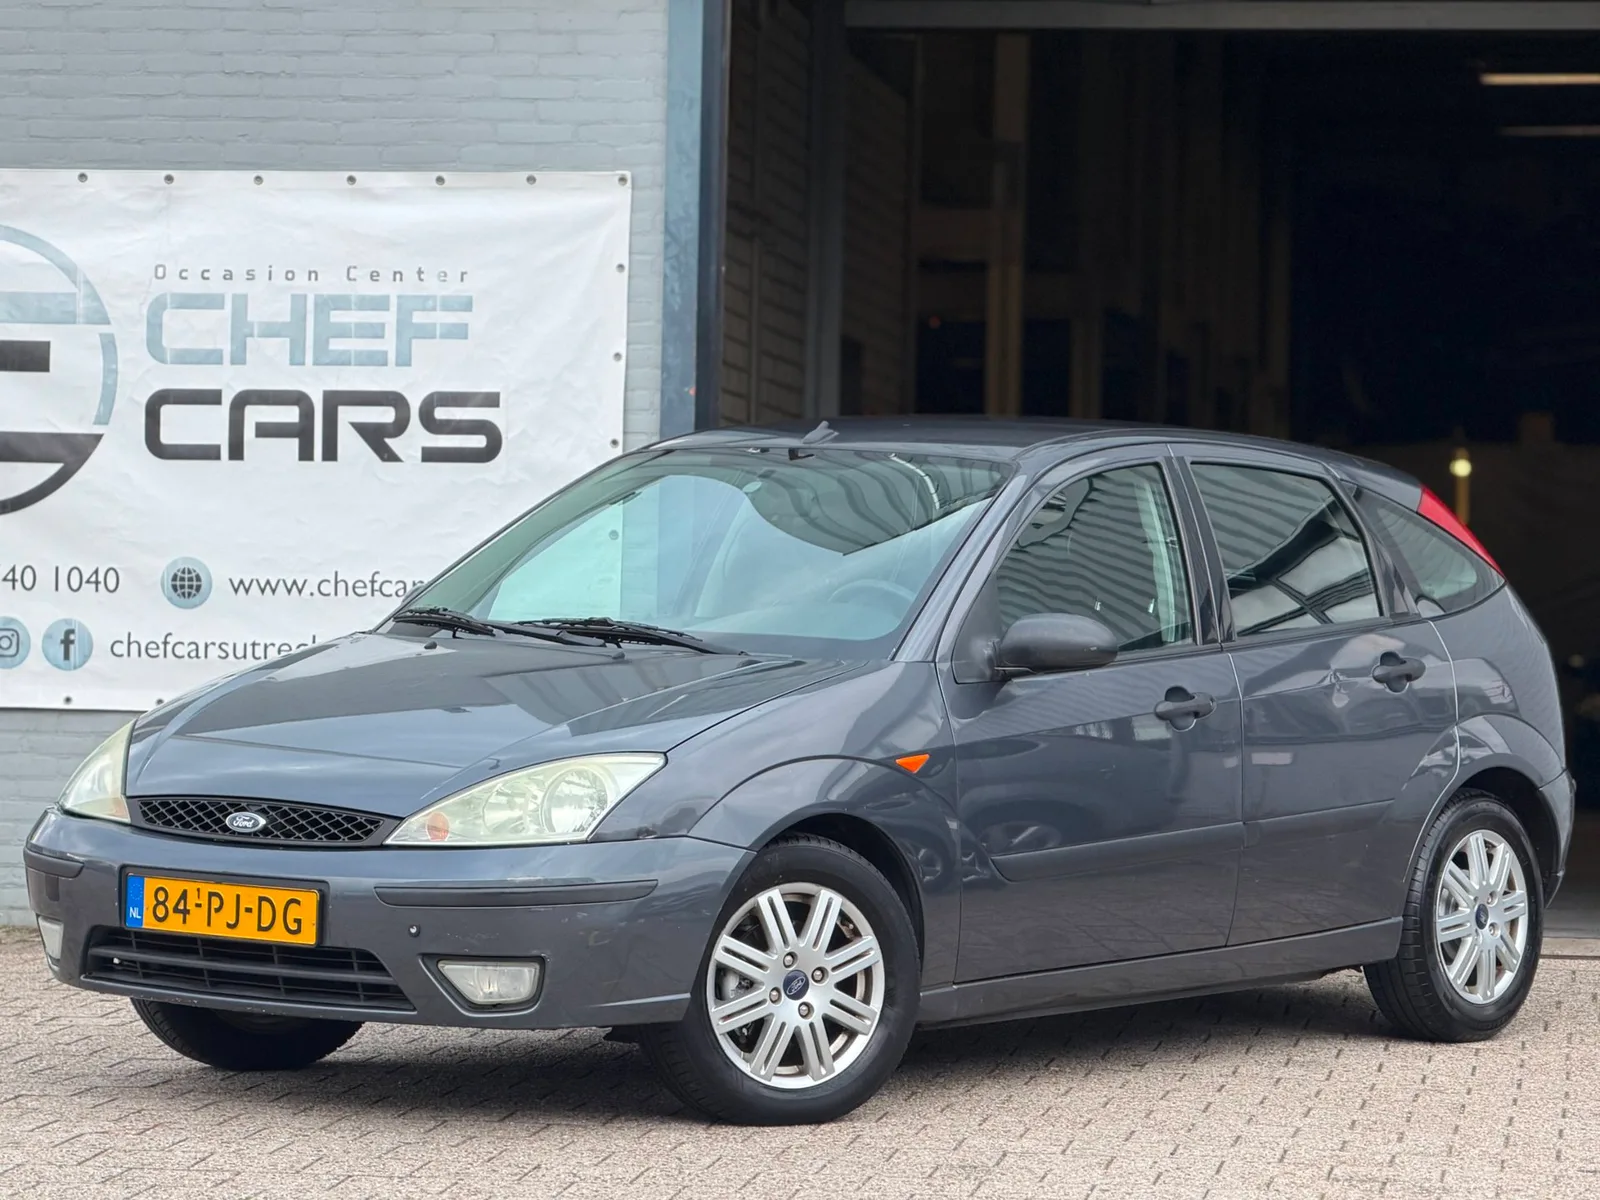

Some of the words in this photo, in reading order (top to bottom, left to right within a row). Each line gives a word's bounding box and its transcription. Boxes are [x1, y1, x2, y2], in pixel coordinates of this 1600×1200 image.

[154, 263, 320, 282] Occasion
[345, 265, 469, 283] Center
[146, 292, 474, 367] CHEF
[144, 388, 503, 463] CARS
[1, 564, 37, 592] 40
[54, 565, 120, 594] 1040
[109, 632, 317, 661] chefcarsutre
[129, 906, 142, 919] NL
[152, 886, 302, 935] 84-PJ-DG
